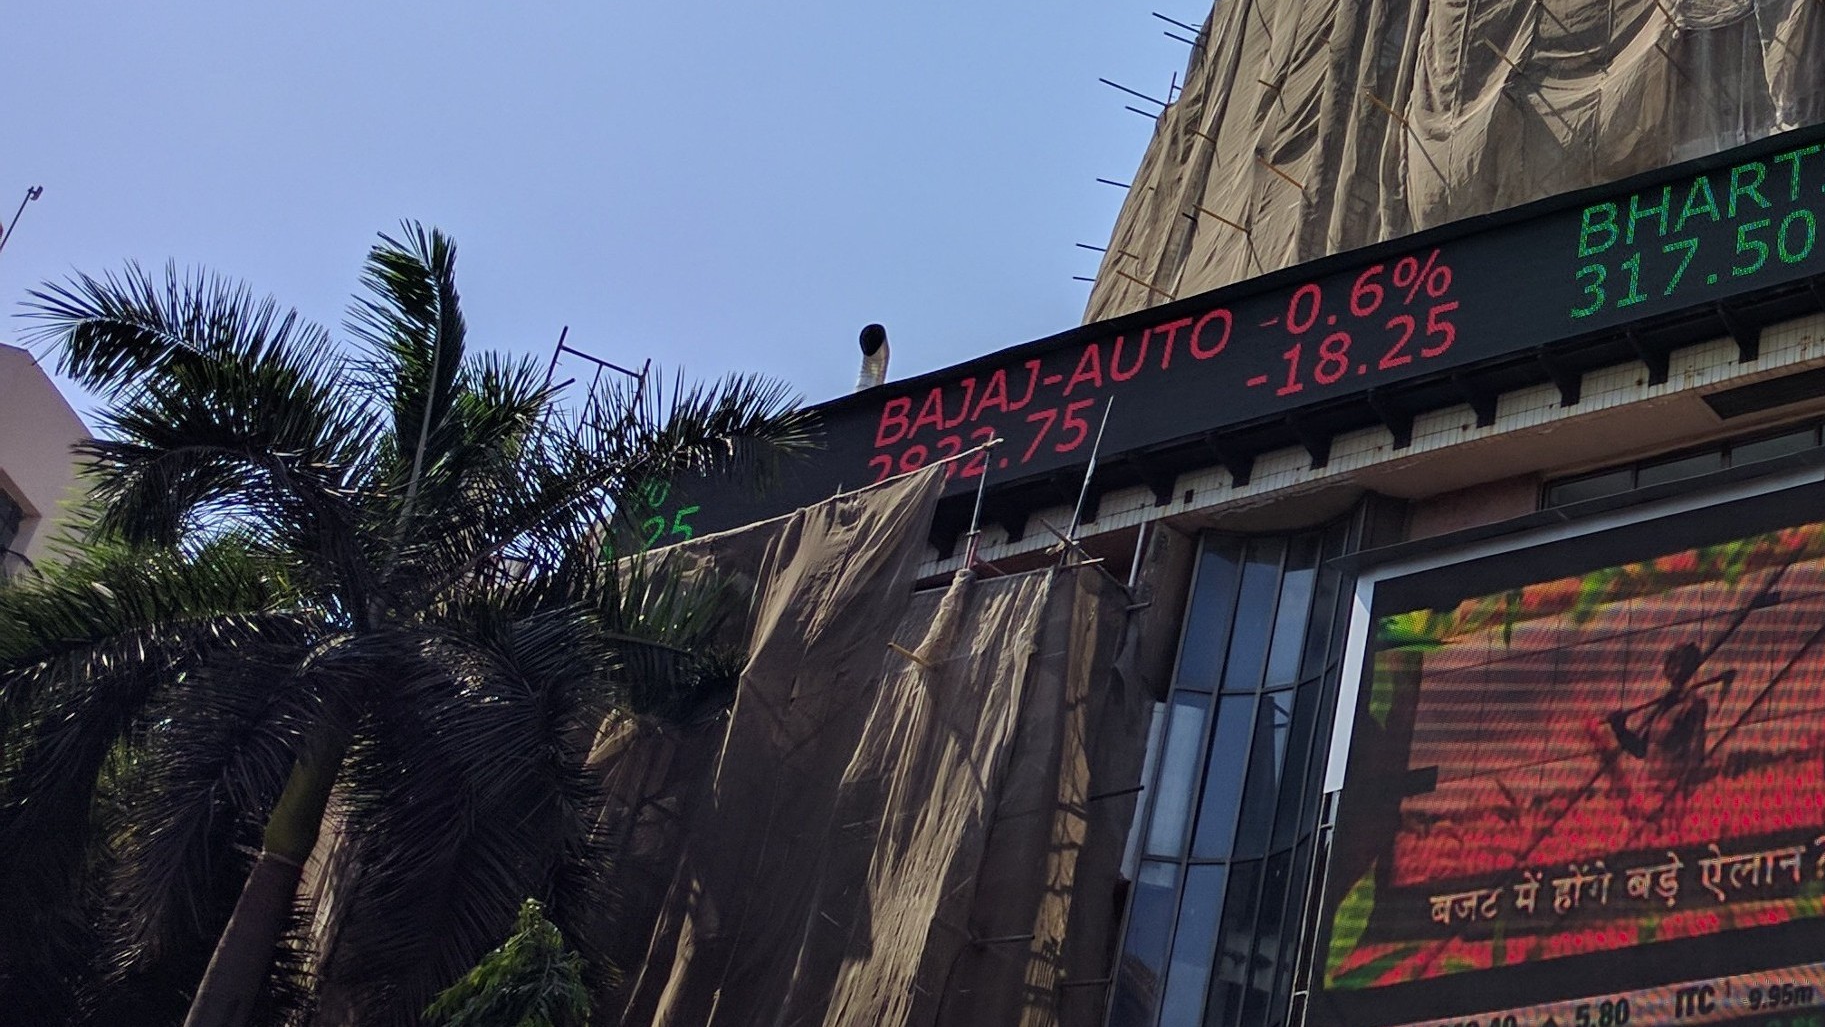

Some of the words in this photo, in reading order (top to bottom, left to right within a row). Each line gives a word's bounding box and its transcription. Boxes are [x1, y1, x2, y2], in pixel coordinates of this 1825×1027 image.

[1570, 208, 1817, 320] 317.50
[875, 308, 1233, 447] BAJAJ-AUTO
[1258, 249, 1453, 335] -0.6%
[1246, 302, 1459, 397] -18.25
[1429, 885, 1503, 925] बजट
[1513, 871, 1543, 915] में
[1625, 851, 1684, 909] बड़े
[1675, 984, 1716, 1020] ITC
[1749, 983, 1815, 1011] 9.95m
